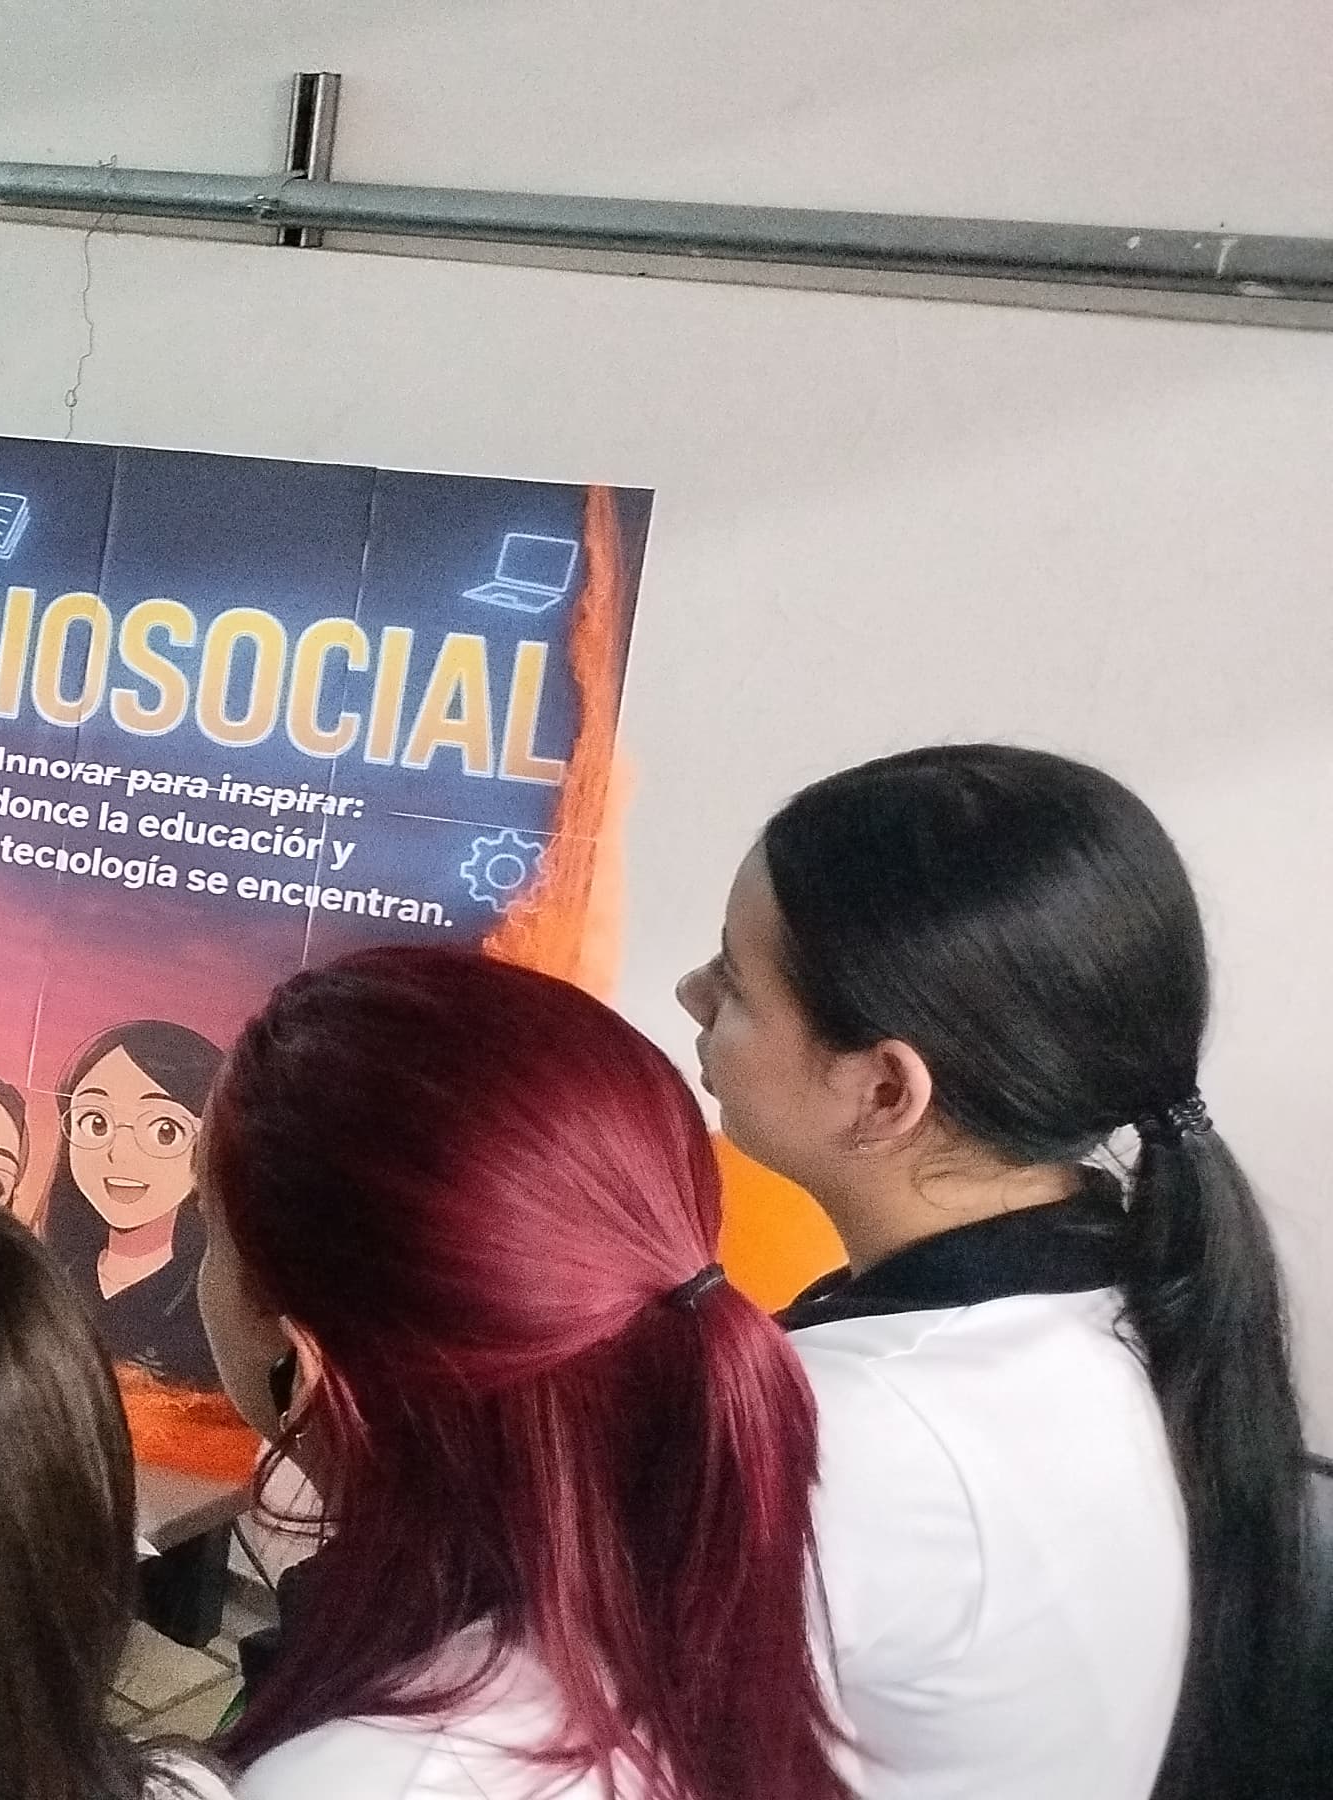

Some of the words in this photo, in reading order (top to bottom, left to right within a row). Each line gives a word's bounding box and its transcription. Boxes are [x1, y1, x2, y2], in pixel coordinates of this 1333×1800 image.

[126, 768, 210, 797] para
[218, 773, 365, 818] inspirar:
[98, 801, 129, 834] la
[330, 840, 356, 870] y
[186, 867, 229, 895] se
